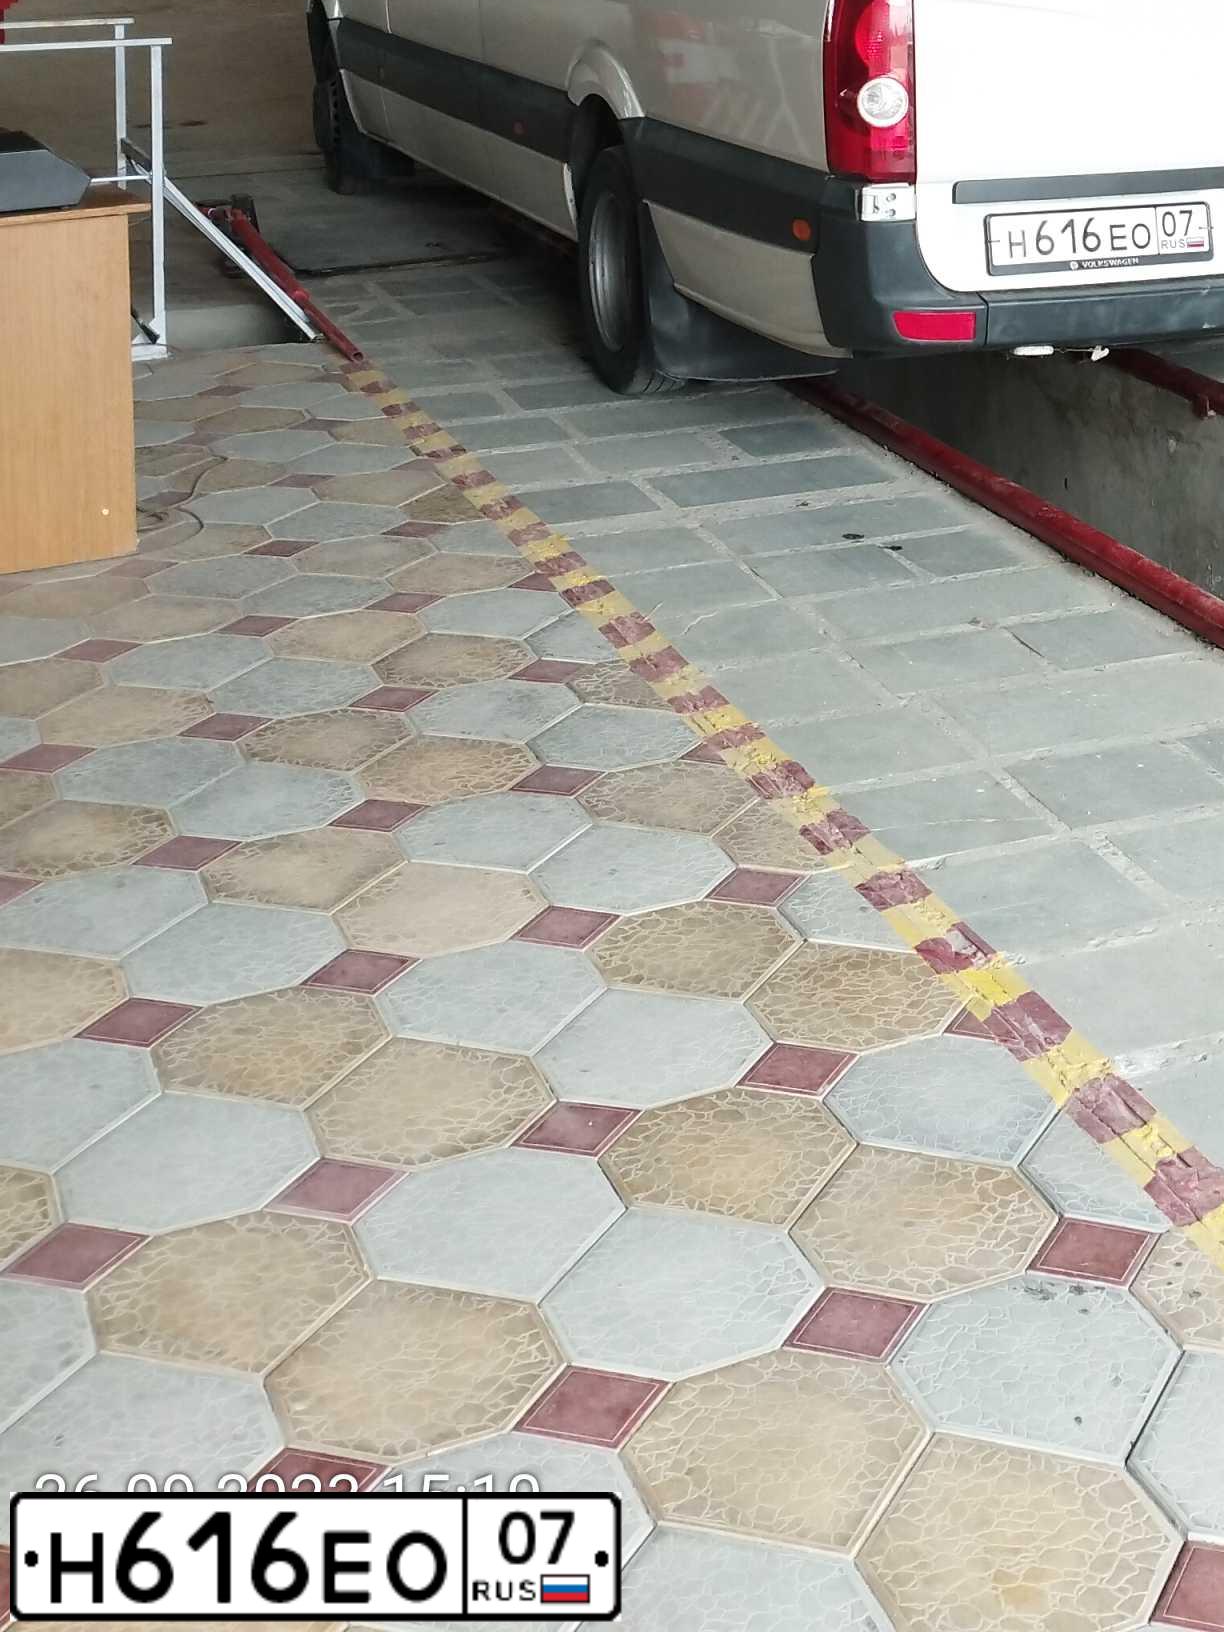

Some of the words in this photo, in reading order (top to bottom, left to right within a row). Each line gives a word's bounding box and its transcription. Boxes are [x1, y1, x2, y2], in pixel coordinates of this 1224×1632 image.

[1162, 210, 1193, 237] 07
[1160, 239, 1186, 249] RUS
[1081, 257, 1139, 269] VOLKSWAGEN
